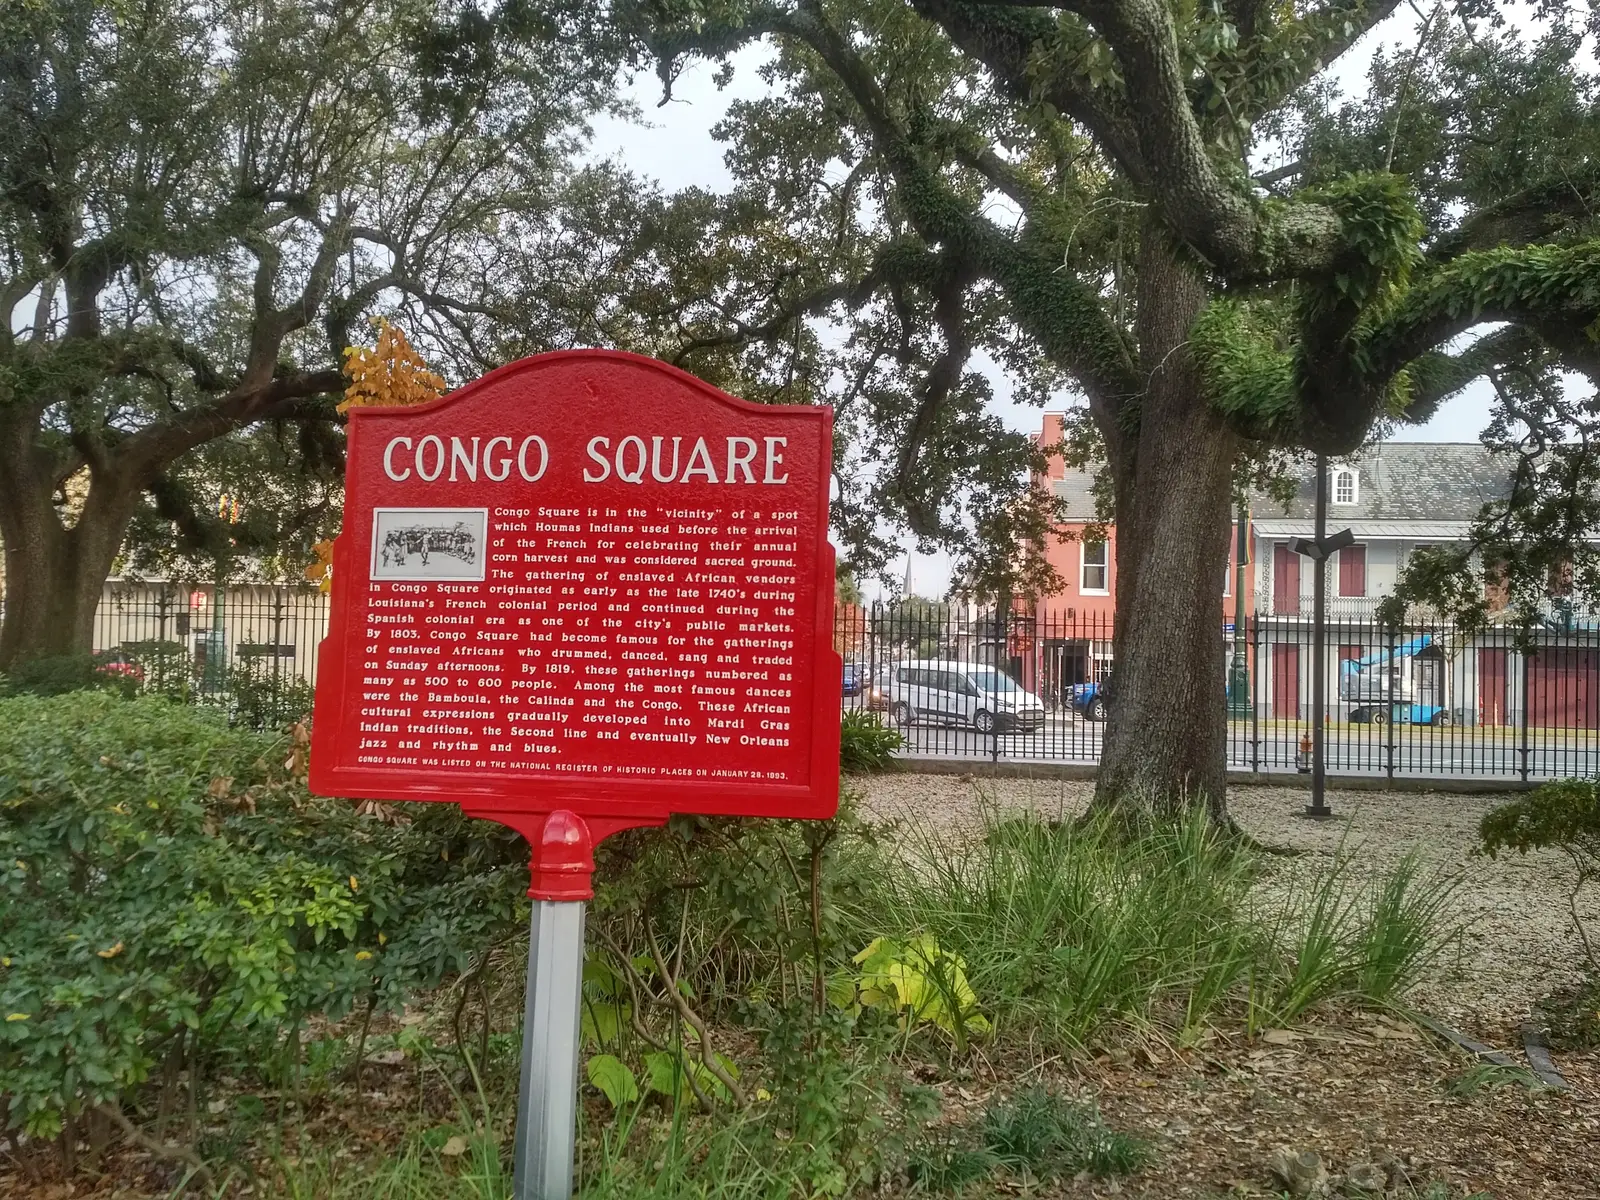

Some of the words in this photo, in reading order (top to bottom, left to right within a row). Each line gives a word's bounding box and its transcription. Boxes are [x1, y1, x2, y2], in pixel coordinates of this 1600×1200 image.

[383, 434, 549, 483] CONGO
[582, 435, 789, 485] SQUARE
[494, 507, 530, 519] Congo
[538, 506, 580, 518] Square
[587, 507, 598, 517] is
[605, 507, 617, 517] in
[626, 507, 647, 518] the
[731, 509, 746, 519] of
[753, 511, 760, 519] a
[771, 510, 799, 521] spot
[494, 522, 527, 532] which
[535, 522, 581, 532] Houmas
[589, 522, 634, 533] Indians
[641, 524, 670, 534] used
[678, 524, 718, 535] before
[726, 525, 747, 535] the
[754, 525, 797, 536] arrival
[492, 537, 505, 547] of
[516, 538, 536, 548] the
[546, 538, 587, 549] French
[597, 539, 616, 549] for
[625, 540, 699, 553] celebrating
[709, 541, 742, 551] their
[753, 542, 797, 552] annual
[492, 553, 518, 562] corn
[524, 553, 568, 563] harvest
[575, 554, 597, 564] and
[604, 556, 626, 564] was
[633, 555, 697, 566] considered
[704, 557, 745, 567] sacred
[750, 558, 797, 569] ground.
[491, 569, 514, 579] The
[525, 570, 585, 583] gathering
[595, 571, 609, 581] of
[618, 572, 674, 582] enslaved
[684, 572, 736, 584] African
[745, 574, 796, 585] vendors
[369, 582, 381, 592] in
[391, 583, 428, 595] Congo
[436, 583, 479, 595] Square
[489, 584, 552, 596] originated
[561, 586, 575, 595] as
[583, 586, 617, 597] early
[626, 588, 640, 597] as
[648, 587, 668, 597] the
[676, 587, 700, 598] late
[708, 588, 746, 599] 1740's
[753, 590, 795, 603] during
[368, 597, 435, 608] Louisiana's
[445, 598, 487, 609] French
[498, 600, 547, 610] colonial
[557, 601, 598, 612] period
[607, 603, 630, 612] and
[641, 603, 705, 614] continued
[716, 605, 759, 618] during
[774, 606, 795, 616] the
[367, 613, 414, 624] Spanish
[425, 614, 474, 625] colonial
[485, 616, 505, 625] era
[518, 617, 531, 625] as
[541, 617, 564, 626] one
[576, 617, 590, 627] of
[602, 618, 623, 628] the
[634, 618, 671, 631] city's
[686, 620, 726, 632] public
[739, 622, 794, 633] markets.
[366, 628, 381, 639] By
[429, 630, 467, 642] Congo
[476, 630, 519, 642] Square
[530, 631, 553, 642] had
[561, 632, 607, 643] become
[616, 633, 658, 645] famous
[667, 635, 686, 646] for
[693, 636, 715, 646] the
[723, 637, 794, 651] gatherings
[365, 644, 378, 654] of
[388, 644, 441, 655] enslaved
[452, 645, 504, 656] Africans
[517, 647, 541, 657] who
[678, 653, 708, 665] sang
[716, 654, 740, 664] and
[752, 655, 793, 666] traded
[364, 661, 379, 670] on
[385, 659, 429, 672] Sunday
[437, 661, 505, 672] afternoons.
[521, 663, 537, 675] By
[584, 664, 618, 675] these
[626, 666, 695, 680] gatherings
[705, 669, 768, 681] numbered
[778, 673, 792, 681] as
[363, 677, 394, 687] many
[403, 677, 416, 686] as
[424, 676, 449, 686] 500
[456, 677, 469, 687] to
[477, 677, 502, 688] 600
[511, 679, 557, 691] people.
[574, 680, 615, 693] Among
[624, 682, 644, 692] the
[653, 684, 683, 694] most
[691, 684, 735, 696] famous
[745, 686, 792, 698] dances
[362, 692, 391, 701] were
[399, 691, 419, 702] the
[499, 694, 519, 704] the
[527, 695, 575, 706] Calinda
[583, 697, 606, 707] and
[615, 698, 635, 709] the
[642, 699, 682, 712] Congo.
[697, 701, 735, 712] These
[743, 702, 791, 714] African
[360, 706, 411, 717] cultural
[422, 709, 495, 720] expressions
[507, 711, 569, 724] gradually
[582, 713, 648, 726] developed
[664, 715, 691, 727] into
[707, 717, 745, 729] Mardi
[760, 719, 790, 731] Gras
[360, 721, 399, 733] Indian
[482, 725, 502, 736] the
[510, 726, 554, 738] Second
[563, 728, 587, 739] line
[596, 730, 620, 740] and
[629, 732, 697, 745] eventually
[706, 733, 731, 745] New
[739, 735, 790, 747] Orleans
[358, 737, 388, 749] jazz
[398, 739, 421, 749] and
[432, 740, 479, 752] rhythm
[489, 742, 512, 752] and
[523, 743, 562, 754] blues.
[358, 755, 384, 764] CONGO
[386, 756, 418, 765] SQUARE
[422, 758, 439, 766] WAS
[441, 759, 471, 767] LISTED
[475, 760, 487, 768] ON
[490, 760, 506, 769] THE
[510, 761, 551, 770] NATIONAL
[555, 763, 598, 772] REGISTER
[602, 765, 613, 773] OF
[616, 766, 656, 775] HISTORIC
[660, 767, 693, 776] PLACES
[696, 768, 707, 776] ON
[711, 769, 749, 778] JANUARY
